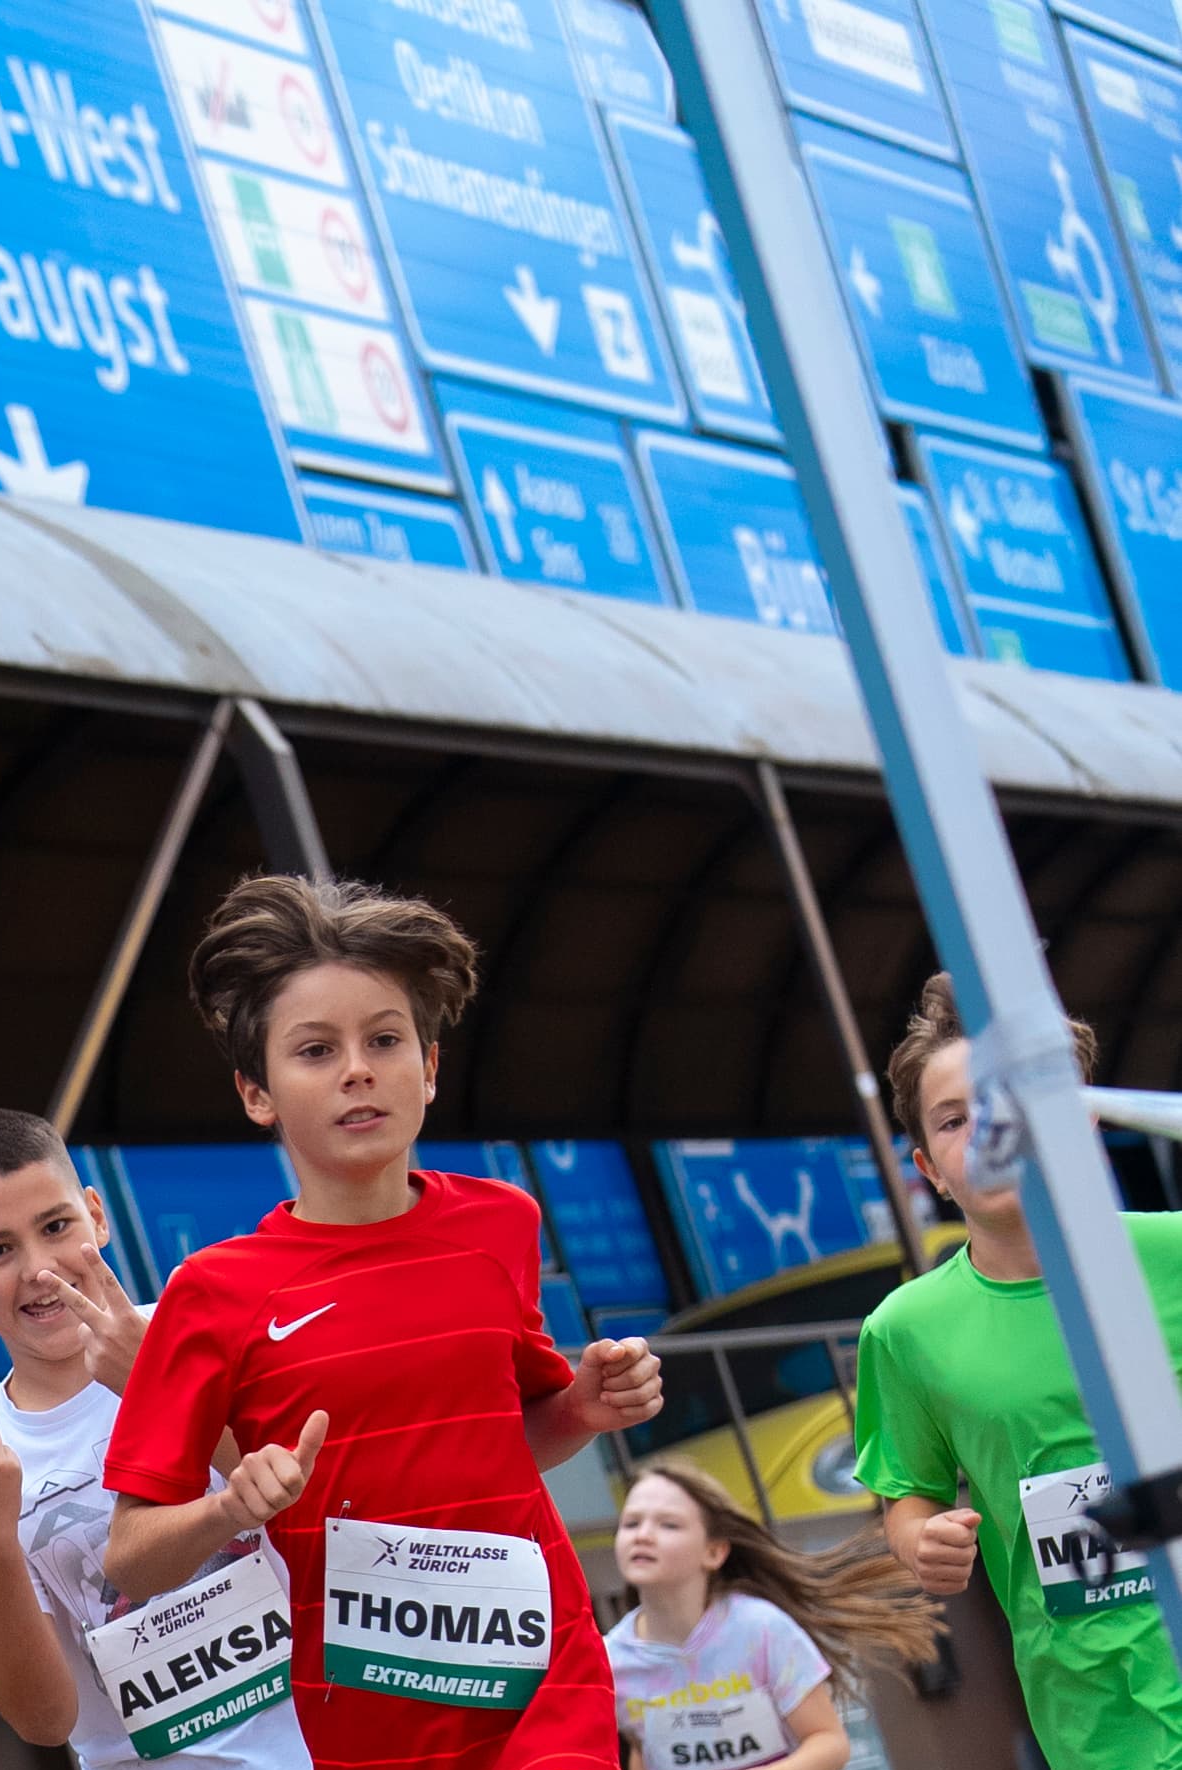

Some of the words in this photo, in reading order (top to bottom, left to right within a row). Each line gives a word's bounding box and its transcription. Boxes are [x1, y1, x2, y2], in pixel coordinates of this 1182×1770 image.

[408, 1542, 509, 1562] WELTKLASSE
[408, 1555, 470, 1575] ZÜRICH
[150, 1579, 233, 1627] WELTKLASSE
[1084, 1576, 1155, 1604] EXTRA
[158, 1607, 206, 1639] ZÜRICH
[329, 1589, 547, 1648] THOMAS
[119, 1609, 292, 1719] ALEKSA
[362, 1664, 508, 1700] EXTRAMEILE
[168, 1676, 285, 1744] EXTRAMEILE
[672, 1734, 761, 1765] SARA
